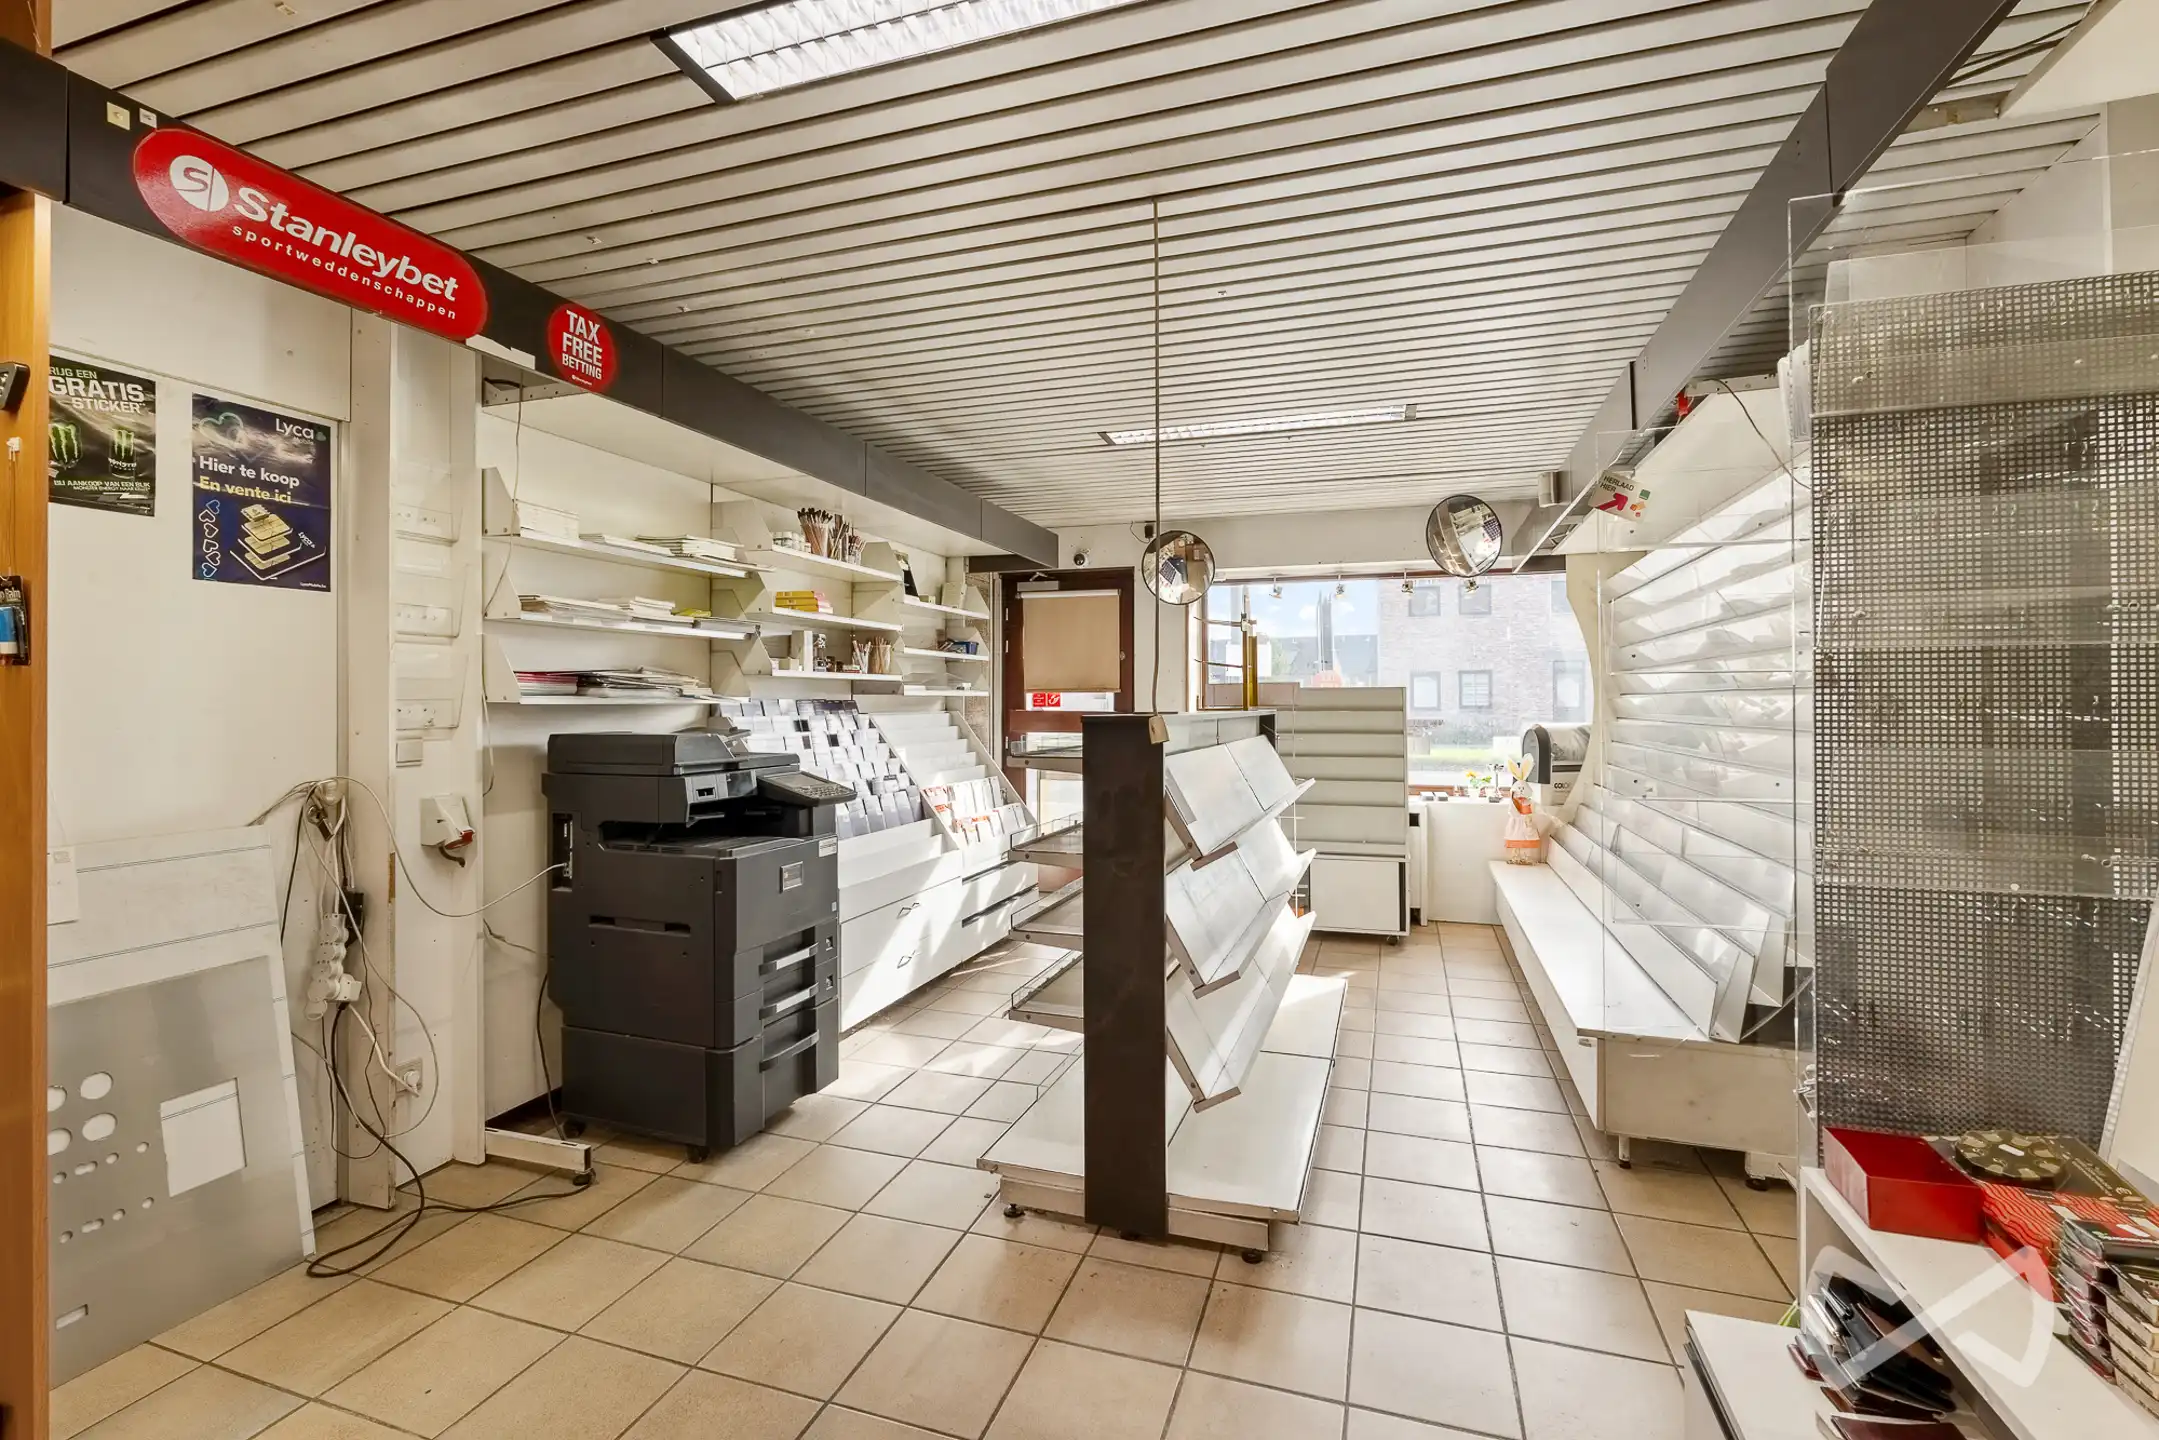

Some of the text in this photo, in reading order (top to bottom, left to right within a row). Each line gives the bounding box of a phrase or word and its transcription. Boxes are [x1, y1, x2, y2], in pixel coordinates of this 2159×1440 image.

[233, 186, 459, 302] Stanleybet
[232, 224, 456, 319] sportweddenschappen
[566, 309, 600, 345] TAX
[562, 332, 602, 367] FREE
[49, 366, 97, 379] RIJG EEN
[562, 353, 602, 380] BETTING
[48, 375, 145, 402] GRATIS
[275, 417, 315, 440] Lyca
[199, 456, 300, 489] Hier te koop
[1603, 475, 1635, 491] HERLAAD
[199, 476, 292, 504] En vente ici
[1600, 482, 1617, 492] HIER
